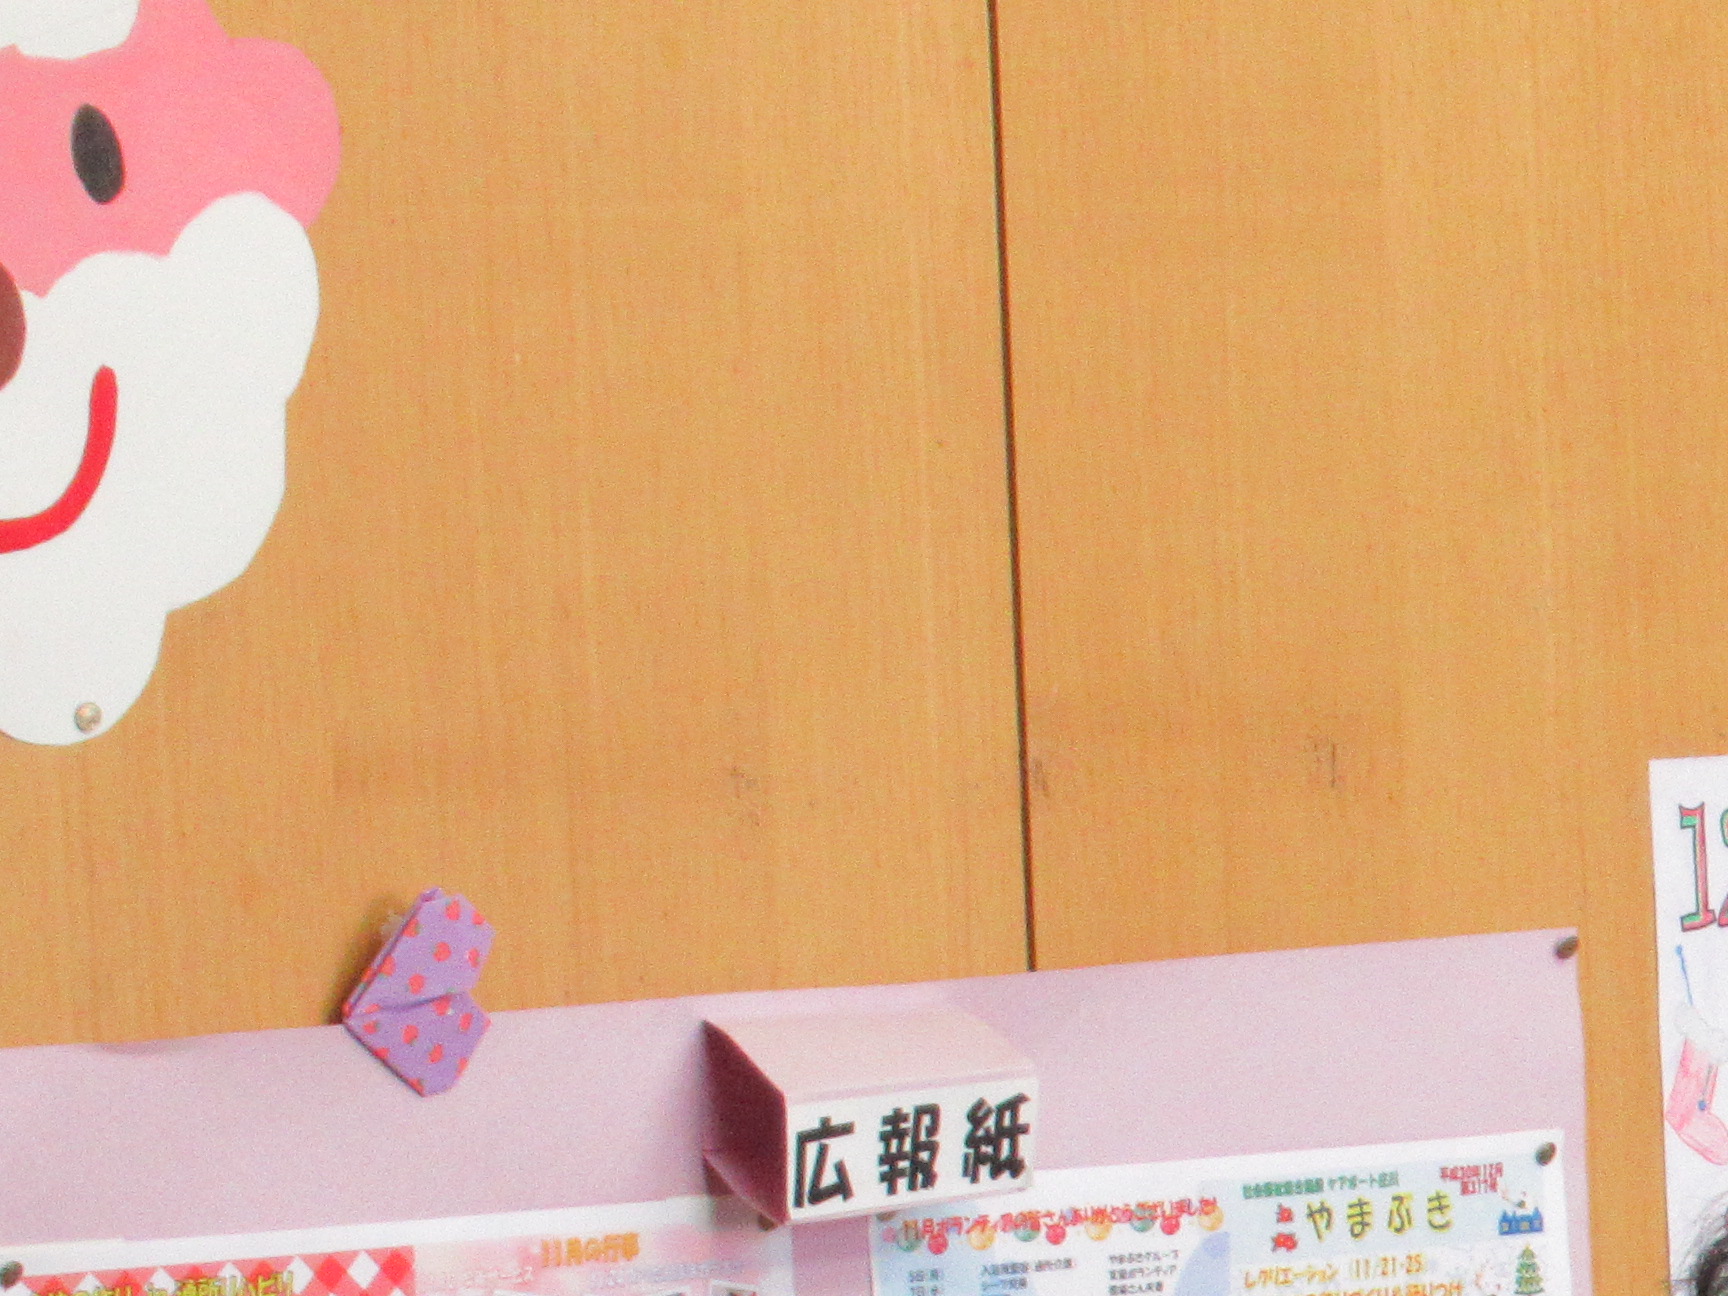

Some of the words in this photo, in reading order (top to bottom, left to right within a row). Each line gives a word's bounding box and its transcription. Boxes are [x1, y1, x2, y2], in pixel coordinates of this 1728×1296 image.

[795, 1092, 1031, 1208] 広報紙
[1305, 1189, 1453, 1242] やまぶき
[541, 1232, 640, 1268] 11月の行事
